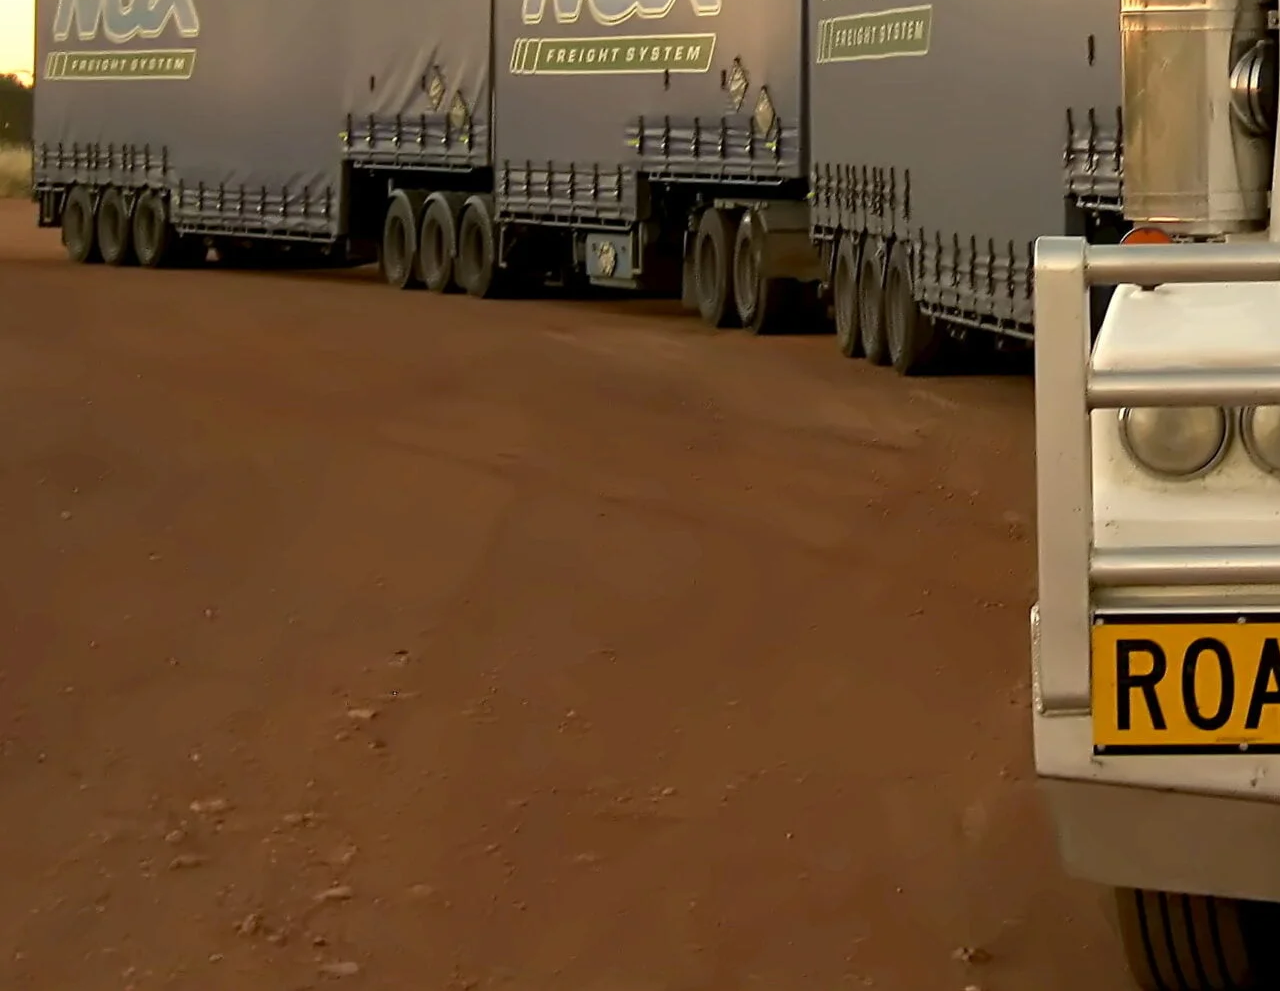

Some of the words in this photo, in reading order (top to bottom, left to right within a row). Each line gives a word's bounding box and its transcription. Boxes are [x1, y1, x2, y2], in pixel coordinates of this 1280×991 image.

[835, 26, 877, 47] FREIGHT
[880, 20, 924, 44] SYSTEM
[546, 47, 620, 63] FREIGHT
[625, 45, 702, 62] SYSTEM
[71, 59, 127, 71] FREIGHT
[130, 58, 186, 70] SYSTEM
